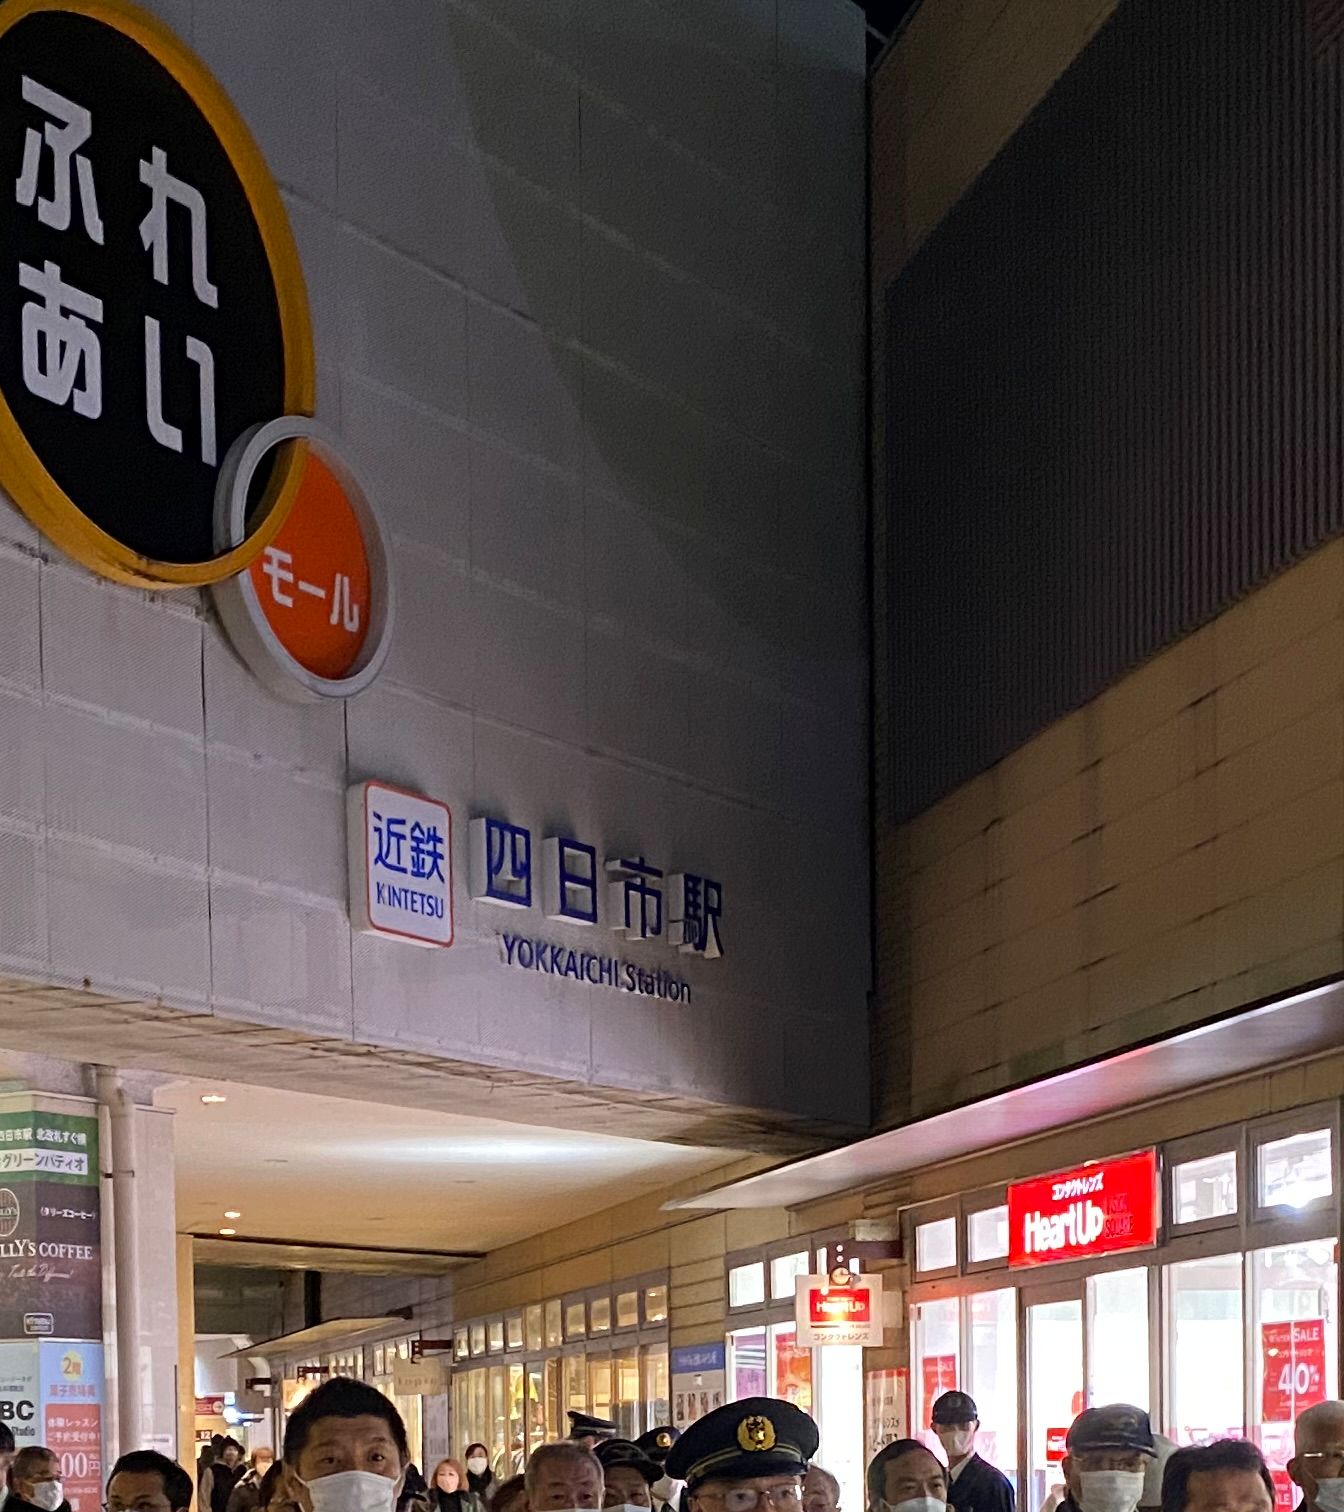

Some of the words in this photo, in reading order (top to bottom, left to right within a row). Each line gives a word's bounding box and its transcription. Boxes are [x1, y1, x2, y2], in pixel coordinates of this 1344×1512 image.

[263, 547, 360, 633] モール
[372, 810, 446, 884] 近鉄
[376, 881, 444, 920] KINTETSU
[480, 818, 725, 958] 四日市駅
[501, 933, 619, 990] YOKKAICHI
[625, 962, 692, 1004] Station
[39, 1241, 94, 1260] COFFEE
[1293, 1327, 1320, 1342] SALE
